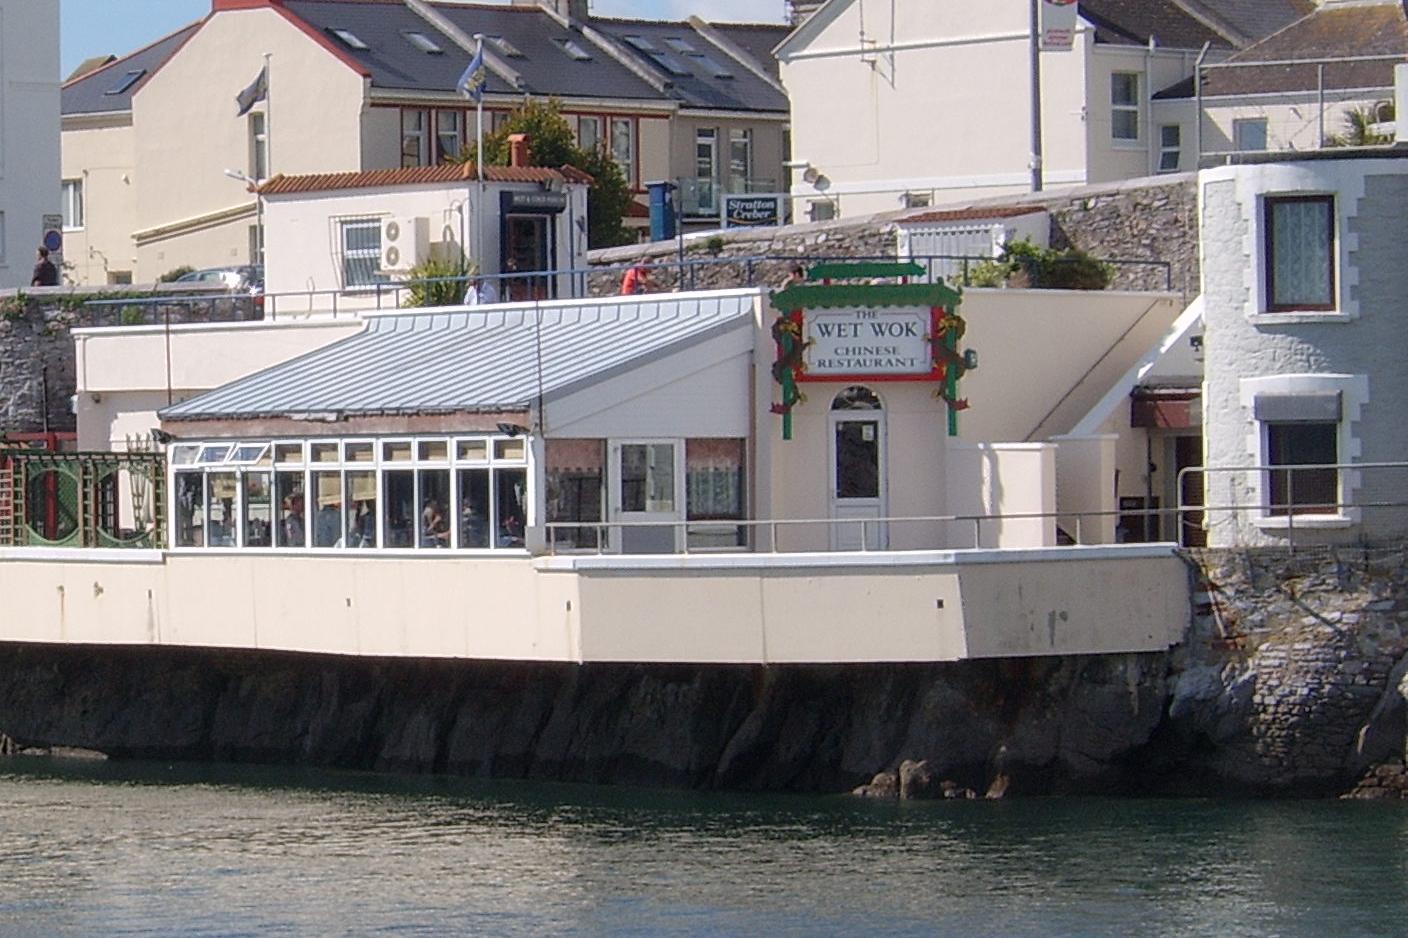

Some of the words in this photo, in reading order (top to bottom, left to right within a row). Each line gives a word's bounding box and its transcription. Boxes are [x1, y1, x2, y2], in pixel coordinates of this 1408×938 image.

[728, 200, 775, 210] Stratton
[733, 209, 771, 219] Creber
[856, 310, 879, 320] THE
[817, 321, 864, 338] WET
[870, 321, 918, 338] WOK
[834, 346, 900, 356] CHINESE
[817, 358, 917, 368] RESTAURANT
